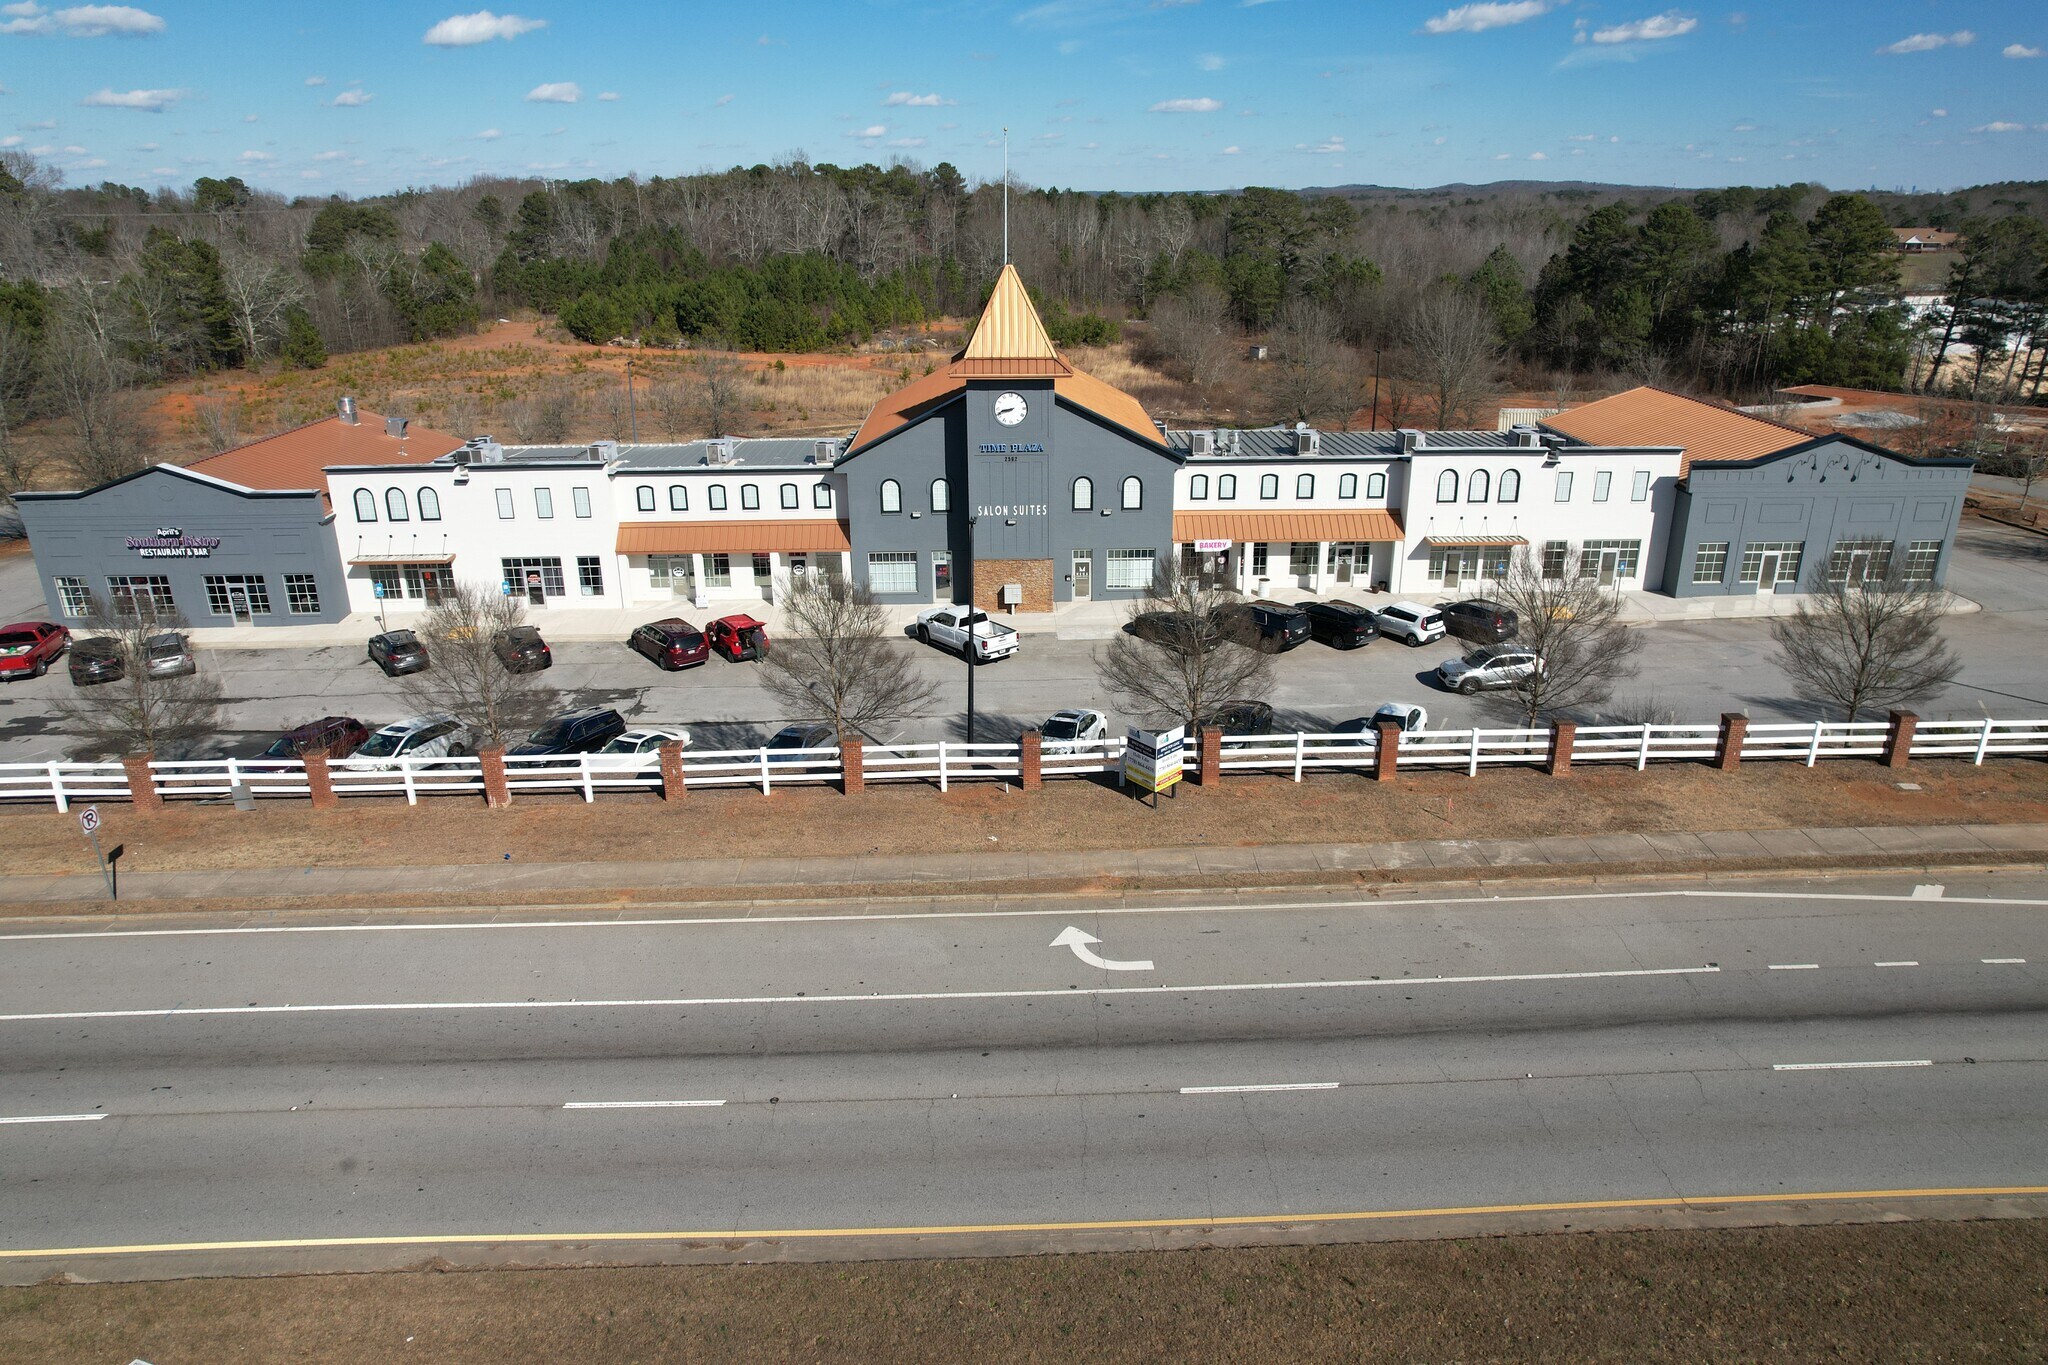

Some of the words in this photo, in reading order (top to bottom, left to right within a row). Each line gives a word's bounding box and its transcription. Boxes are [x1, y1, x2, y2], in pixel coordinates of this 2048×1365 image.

[979, 444, 1007, 453] TIME
[1010, 443, 1044, 452] PLAZA
[978, 505, 1008, 516] SALON
[1013, 505, 1047, 516] SUITES
[157, 528, 180, 536] April's
[125, 536, 179, 548] Southern
[182, 536, 219, 548] Bistro
[140, 548, 186, 556] RESTAURANT
[194, 548, 209, 556] BAR
